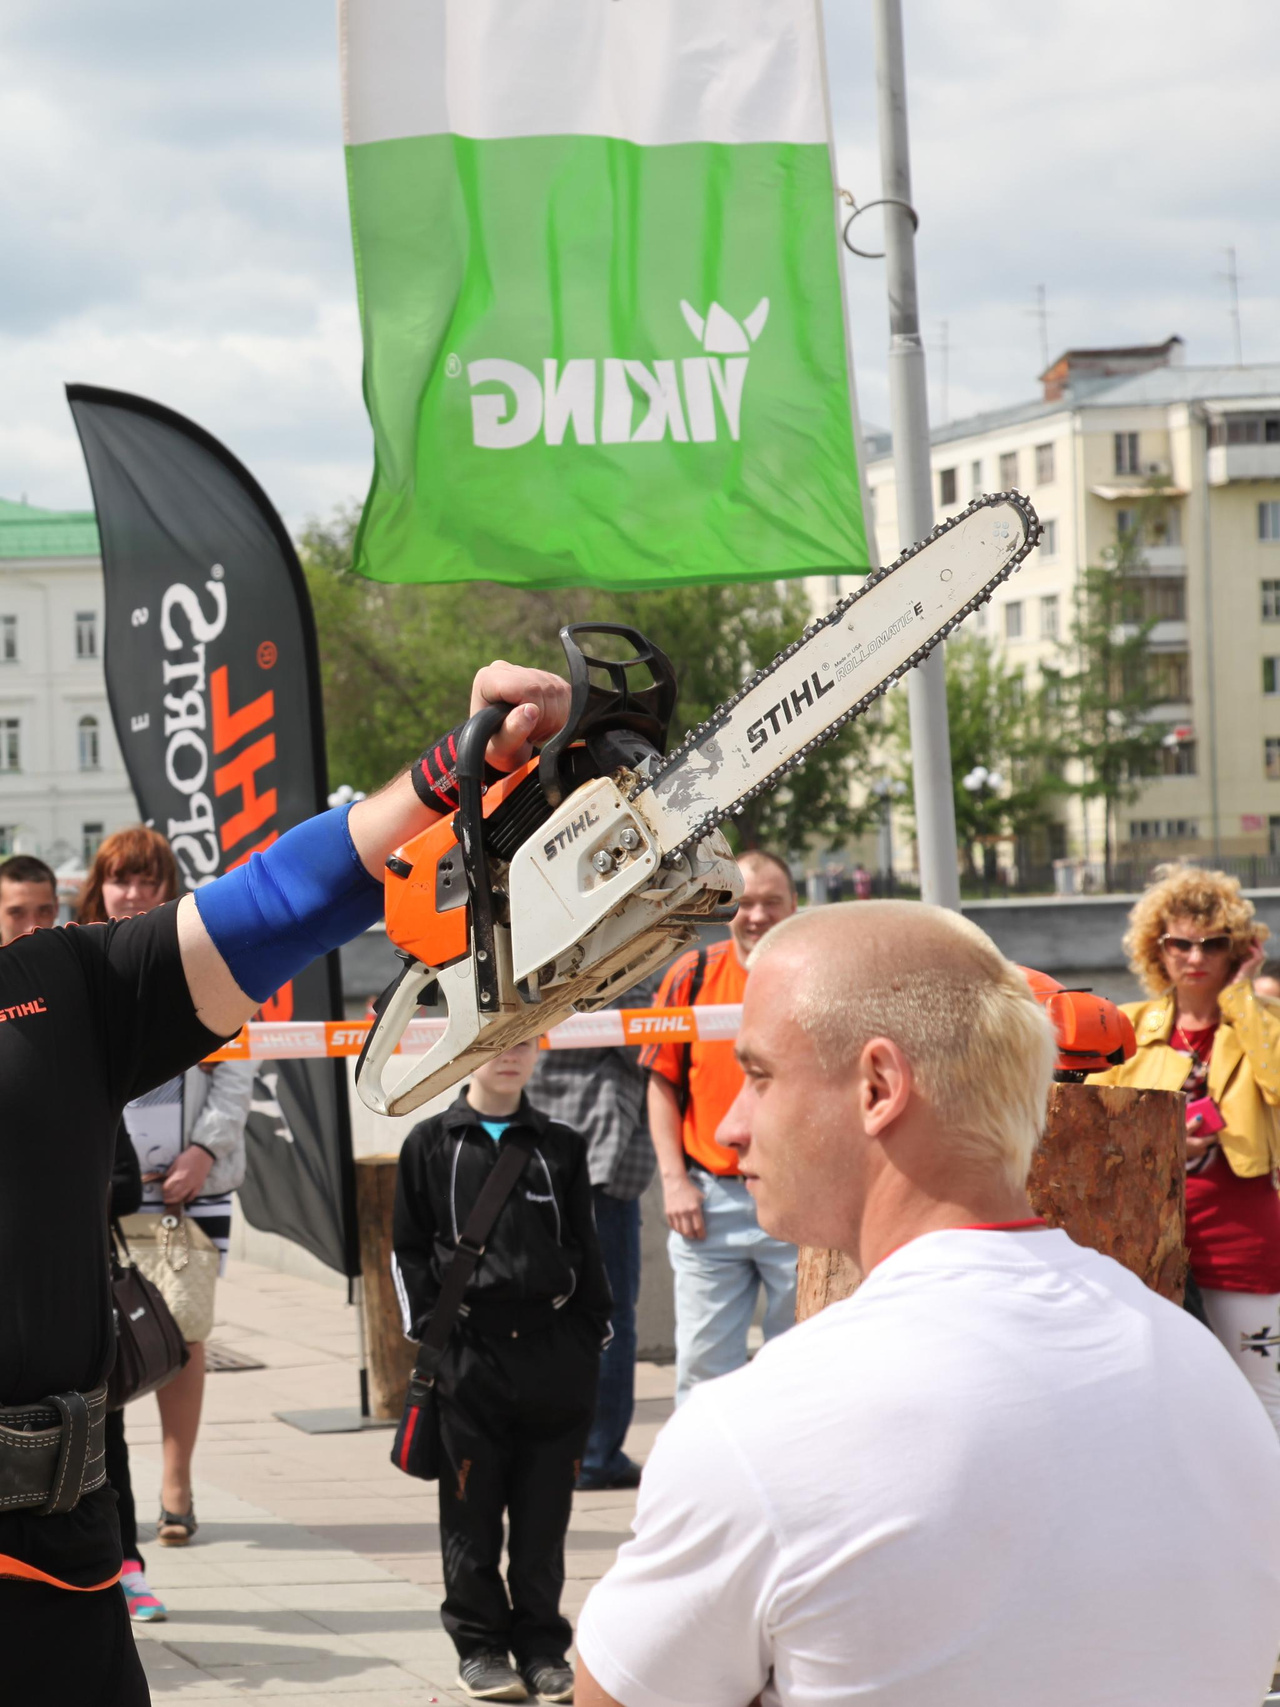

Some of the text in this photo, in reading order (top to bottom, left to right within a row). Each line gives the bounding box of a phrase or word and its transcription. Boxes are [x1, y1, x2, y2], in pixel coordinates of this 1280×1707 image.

[834, 656, 846, 668] Made
[851, 643, 862, 653] USA
[835, 610, 913, 682] ROLLOMATIC
[746, 671, 835, 754] STIHL
[543, 811, 600, 861] STIHL
[331, 1030, 369, 1046] STI
[629, 1016, 691, 1034] STIHL
